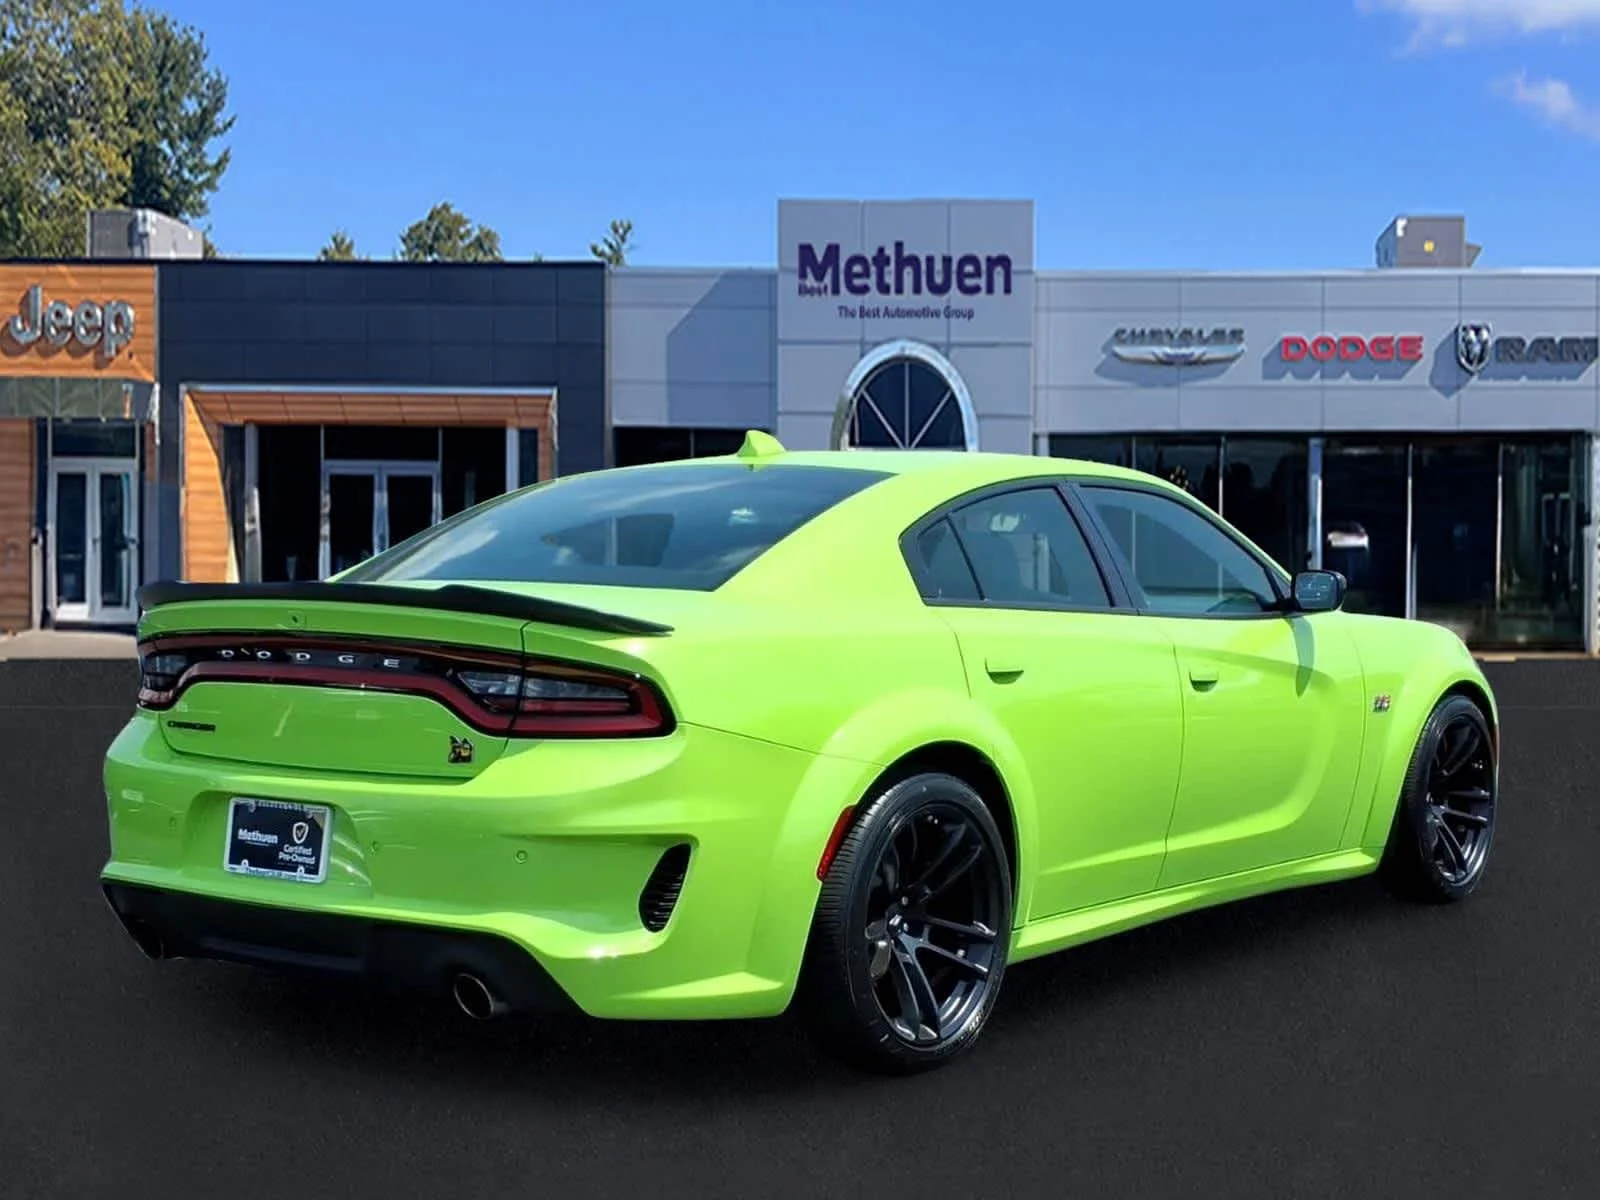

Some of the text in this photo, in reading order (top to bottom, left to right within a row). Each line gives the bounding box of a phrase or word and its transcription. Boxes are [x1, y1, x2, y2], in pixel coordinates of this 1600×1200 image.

[798, 241, 1012, 296] Methuen
[10, 285, 135, 357] Jeep
[838, 305, 974, 320] The Best Automotive Group
[1114, 328, 1244, 344] CHRYSLER
[1281, 336, 1424, 362] DODGE
[1495, 337, 1598, 361] RAM
[221, 649, 400, 668] DODGE
[238, 829, 278, 843] Methuen
[283, 844, 312, 855] Certified
